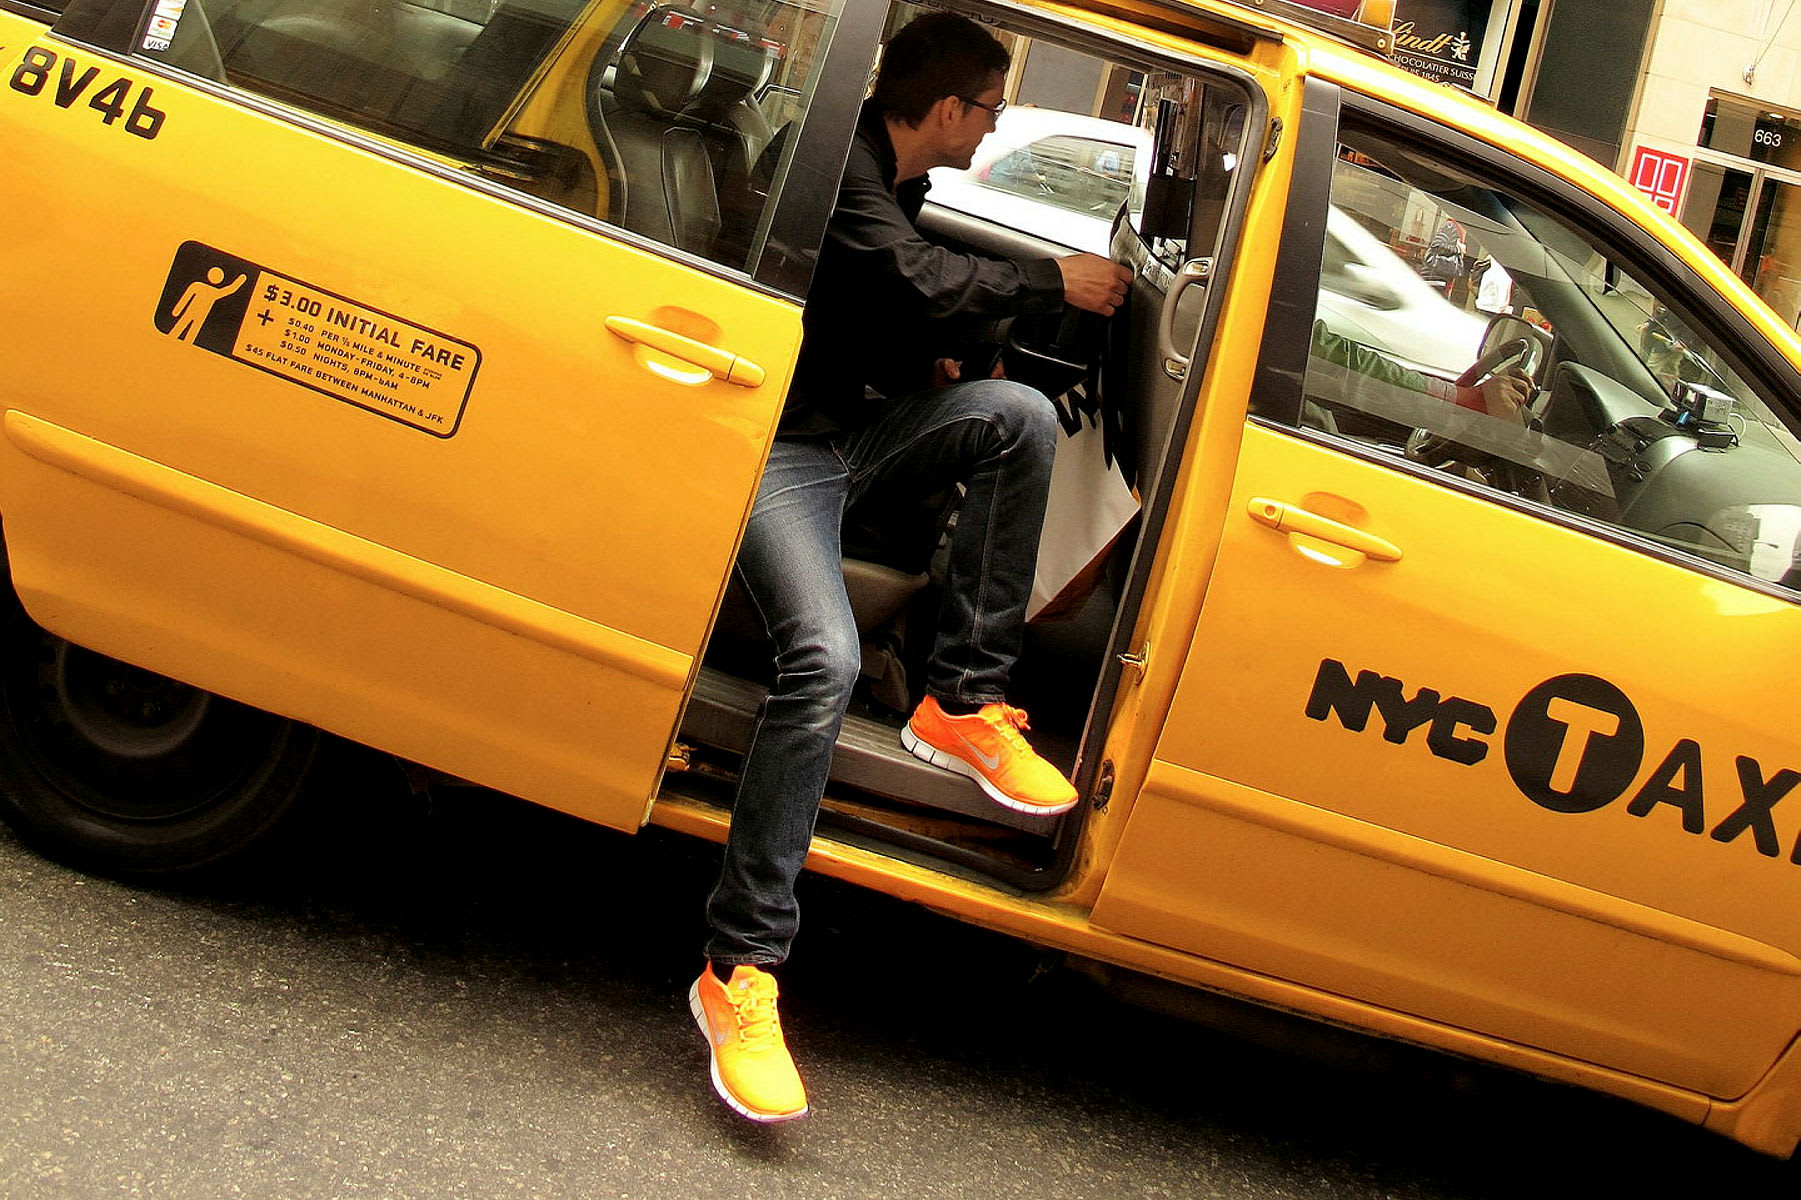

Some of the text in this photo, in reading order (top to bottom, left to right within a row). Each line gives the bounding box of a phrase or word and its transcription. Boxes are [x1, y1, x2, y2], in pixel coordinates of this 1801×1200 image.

[147, 39, 170, 51] VISA
[1450, 67, 1476, 81] SUISS
[1754, 129, 1782, 147] 663
[264, 284, 465, 371] $3.00 INITIAL FARE
[284, 329, 311, 344] $1.00
[280, 340, 307, 355] $0.50
[288, 317, 315, 333] $0.40
[321, 330, 340, 342] PER
[352, 342, 375, 355] MILE
[386, 354, 422, 373] MINUTE
[245, 343, 263, 356] $45
[266, 351, 288, 365] FLAT
[290, 360, 313, 375] FARE
[315, 370, 359, 392] BETWEEN
[361, 387, 416, 413] MANHATTAN
[425, 412, 444, 424] JFK
[1305, 658, 1801, 866] NYC TAX
